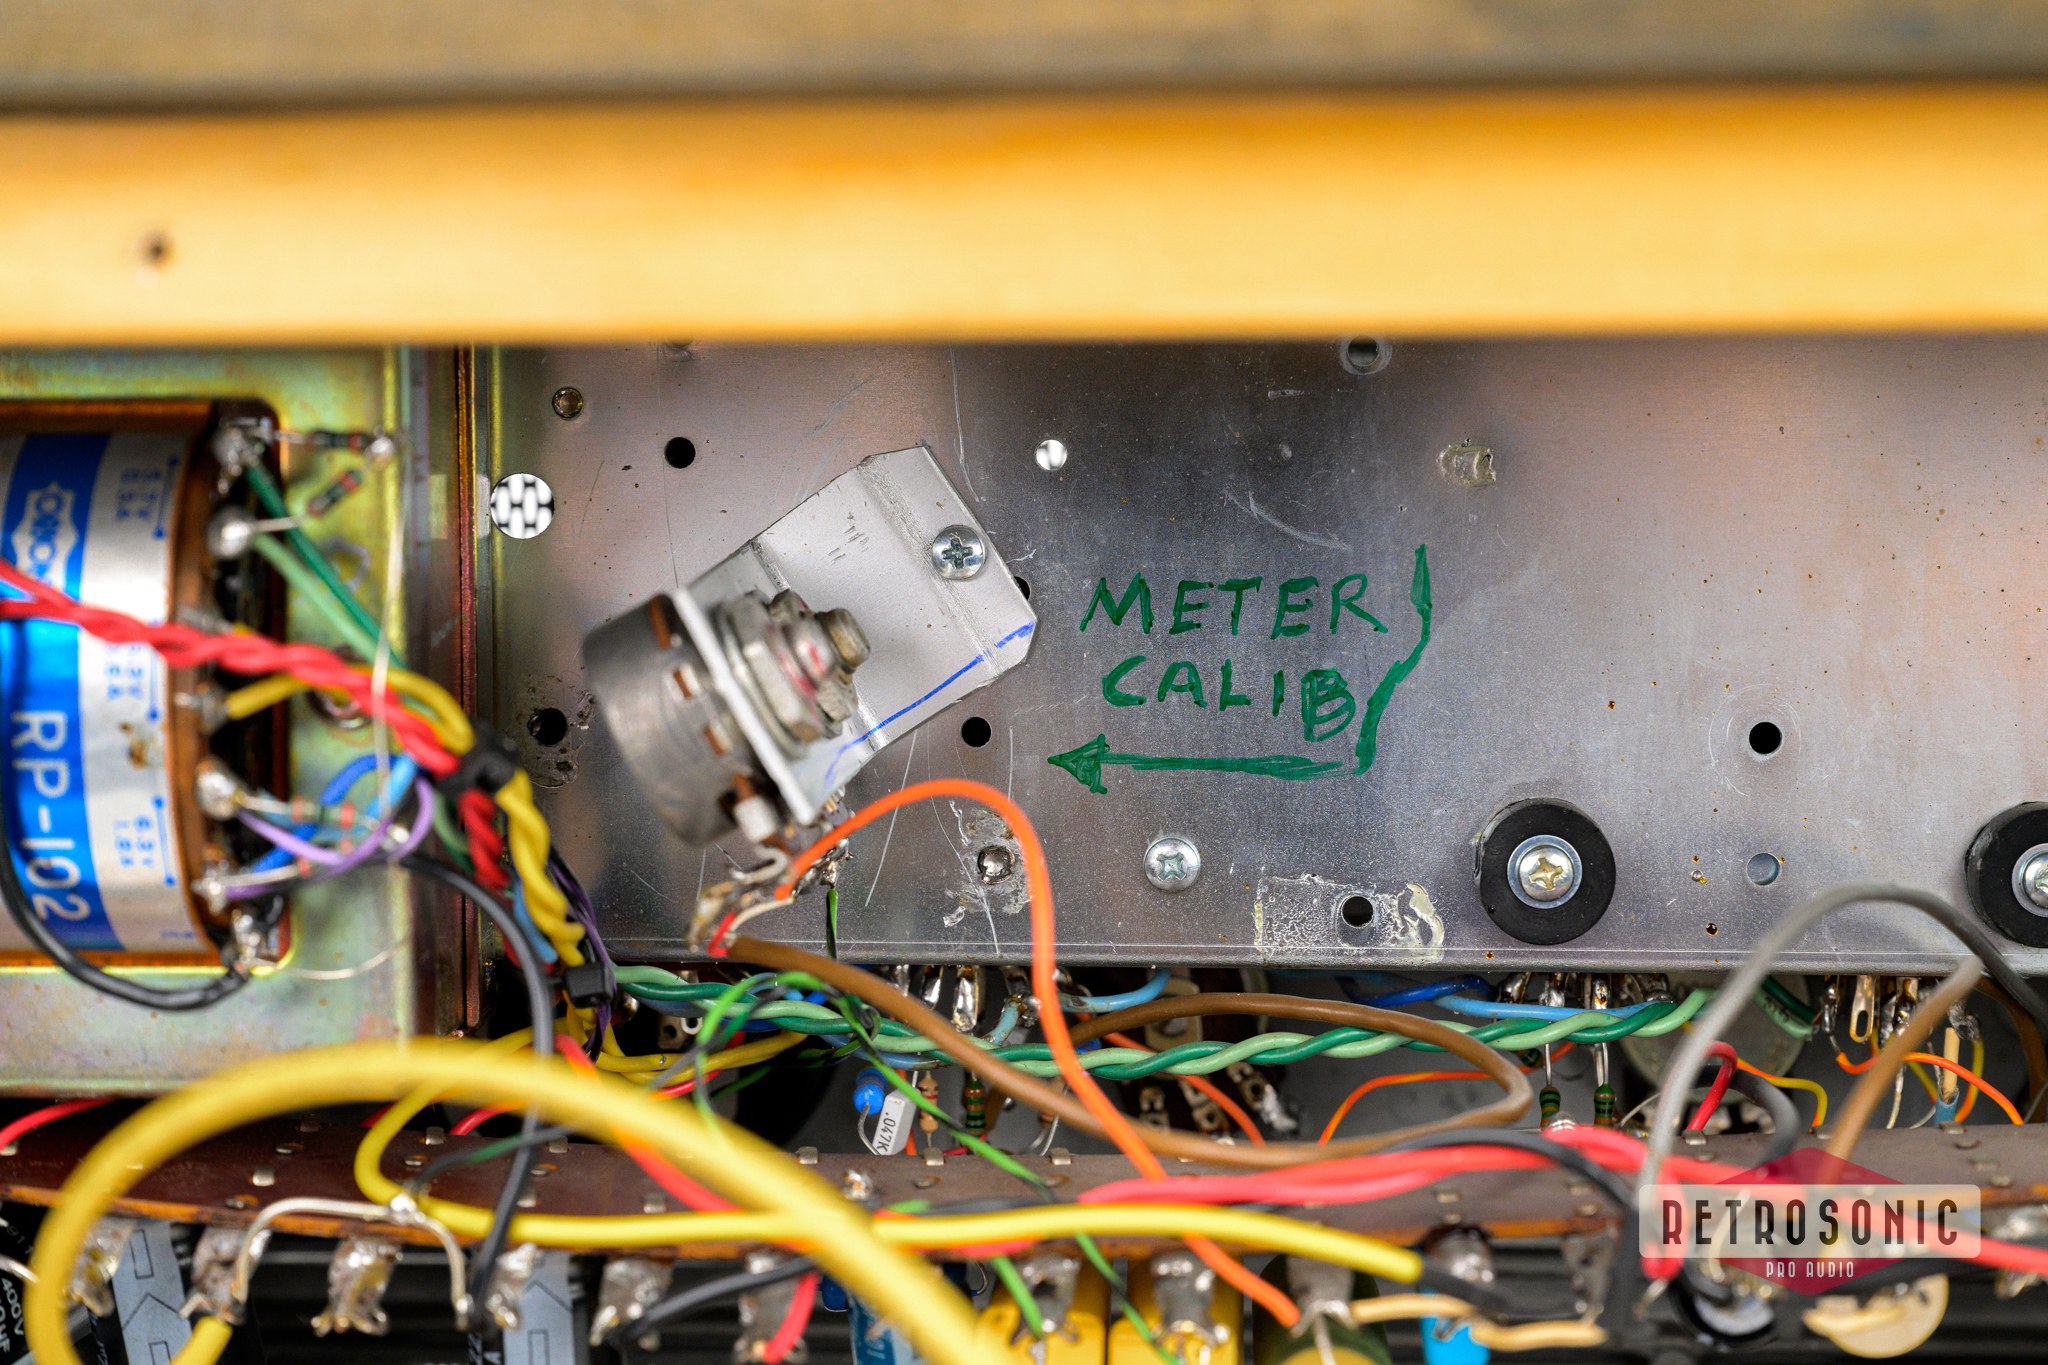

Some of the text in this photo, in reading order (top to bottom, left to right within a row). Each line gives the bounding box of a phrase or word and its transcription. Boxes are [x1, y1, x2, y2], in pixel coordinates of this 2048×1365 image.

[1080, 572, 1388, 640] METER
[1103, 655, 1357, 742] CALIB
[11, 709, 91, 922] RP-102
[877, 1112, 897, 1152] .047K
[2, 1278, 25, 1336] 400V
